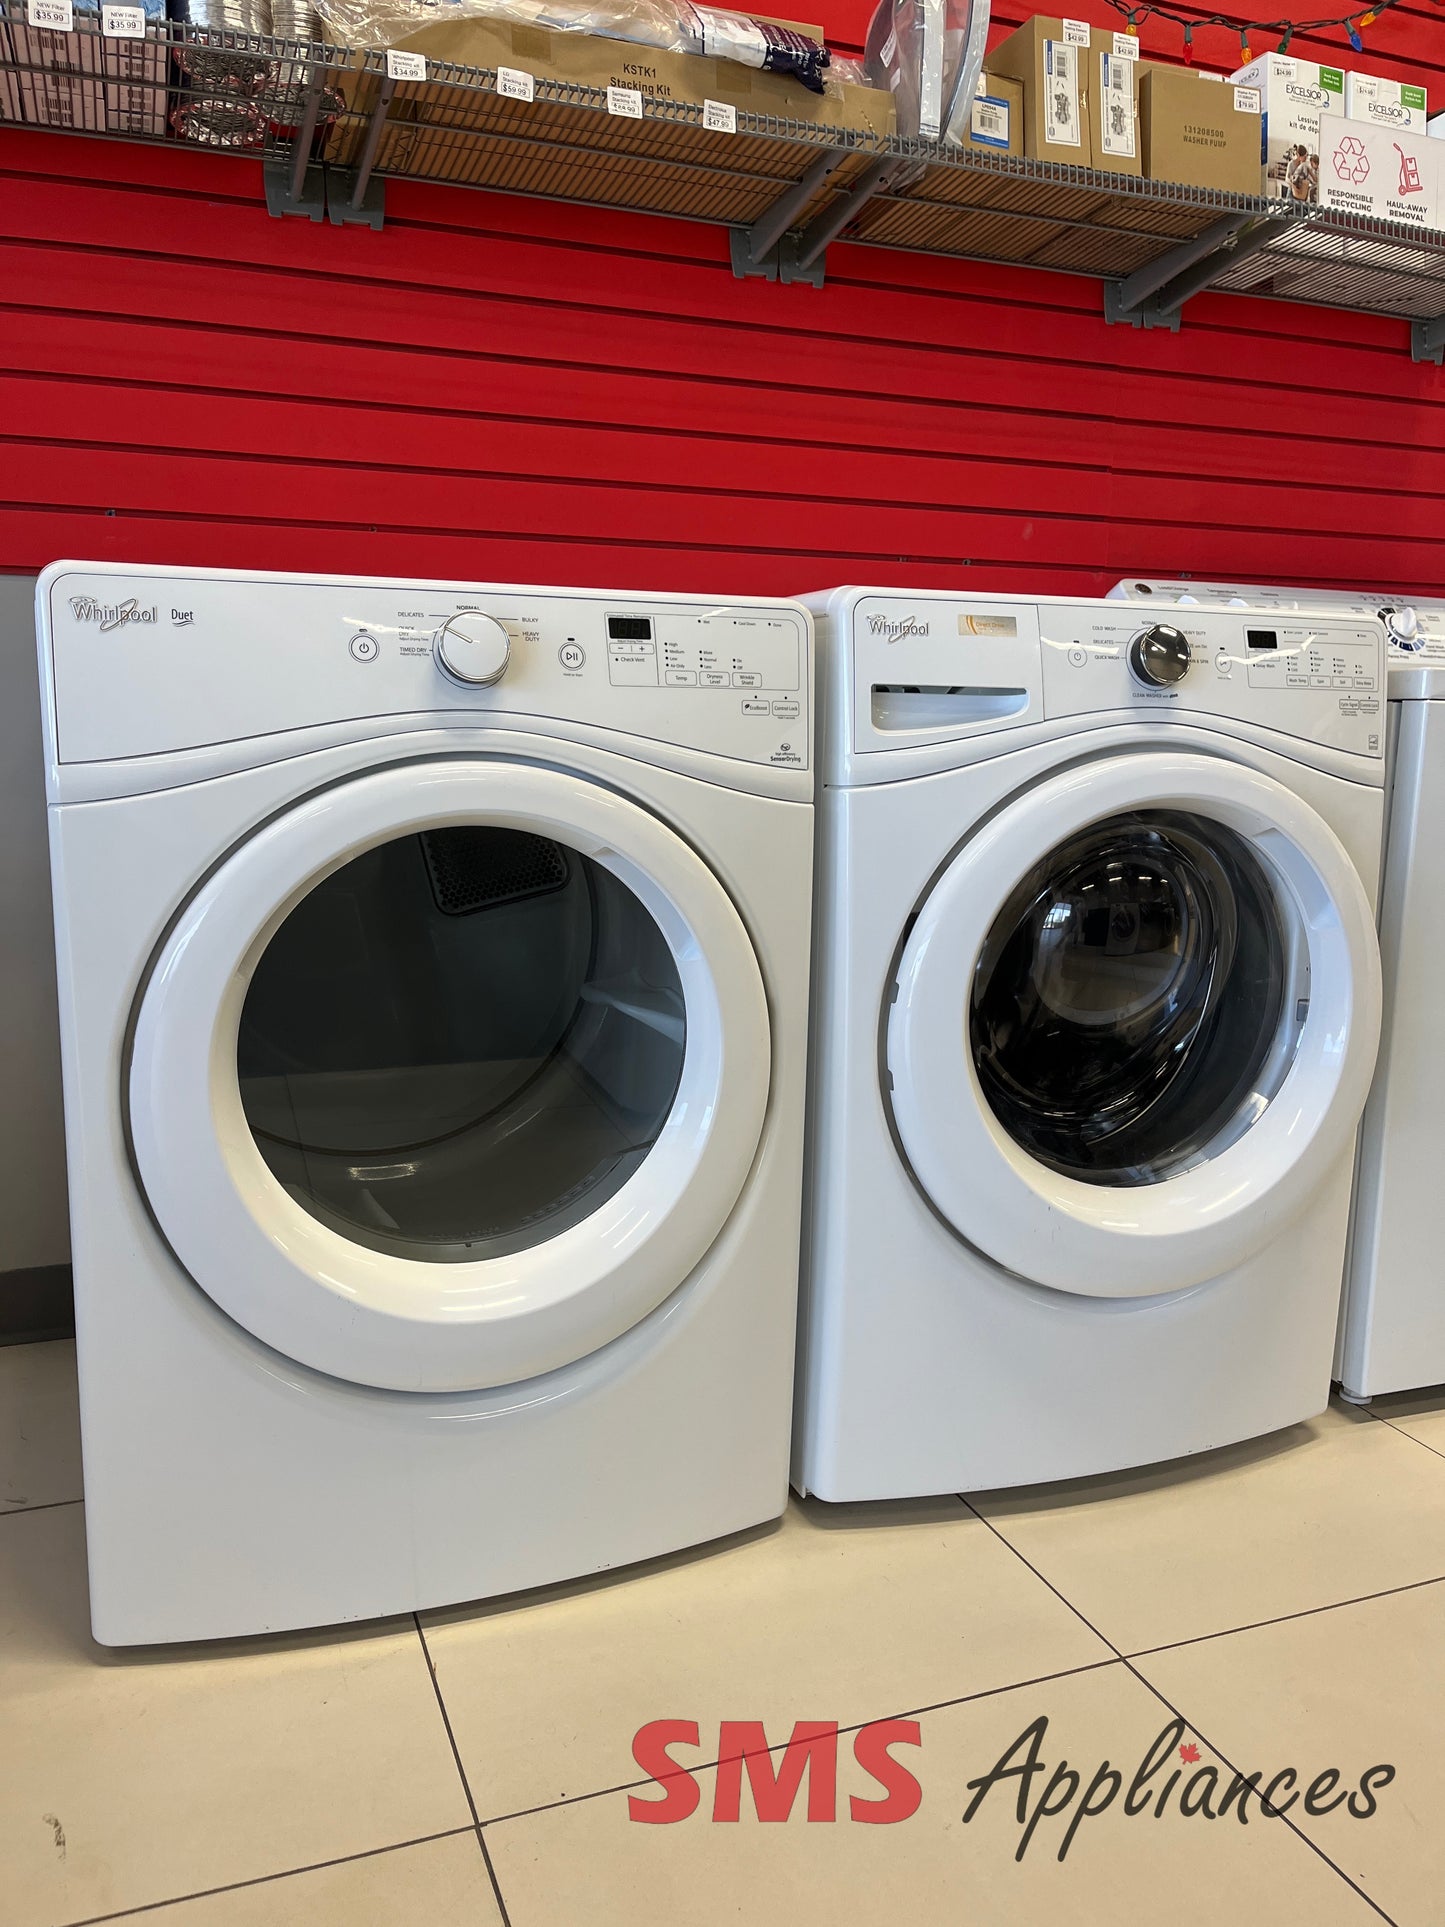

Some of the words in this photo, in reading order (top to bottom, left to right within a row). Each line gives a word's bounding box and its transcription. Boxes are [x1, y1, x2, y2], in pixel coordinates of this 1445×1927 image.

[623, 63, 657, 79] KSTK1
[610, 76, 655, 96] Stacking
[656, 84, 672, 97] Kit
[1285, 83, 1322, 101] EXCELSIOR
[1368, 102, 1403, 119] EXCELSIOR
[1289, 121, 1298, 129] kit
[1297, 115, 1319, 127] Lessive
[1183, 125, 1225, 138] 131208500
[1183, 135, 1209, 146] WASHER
[1209, 139, 1227, 148] PUMP
[1327, 188, 1374, 204] RESPONSIBLE
[1330, 198, 1372, 213] RECYCLING
[1386, 200, 1428, 214] HAUL-AWAY
[1389, 209, 1425, 222] REMOVAL
[69, 596, 158, 632] Whirlpool
[171, 608, 194, 621] Duet
[867, 614, 929, 643] Whirlpool
